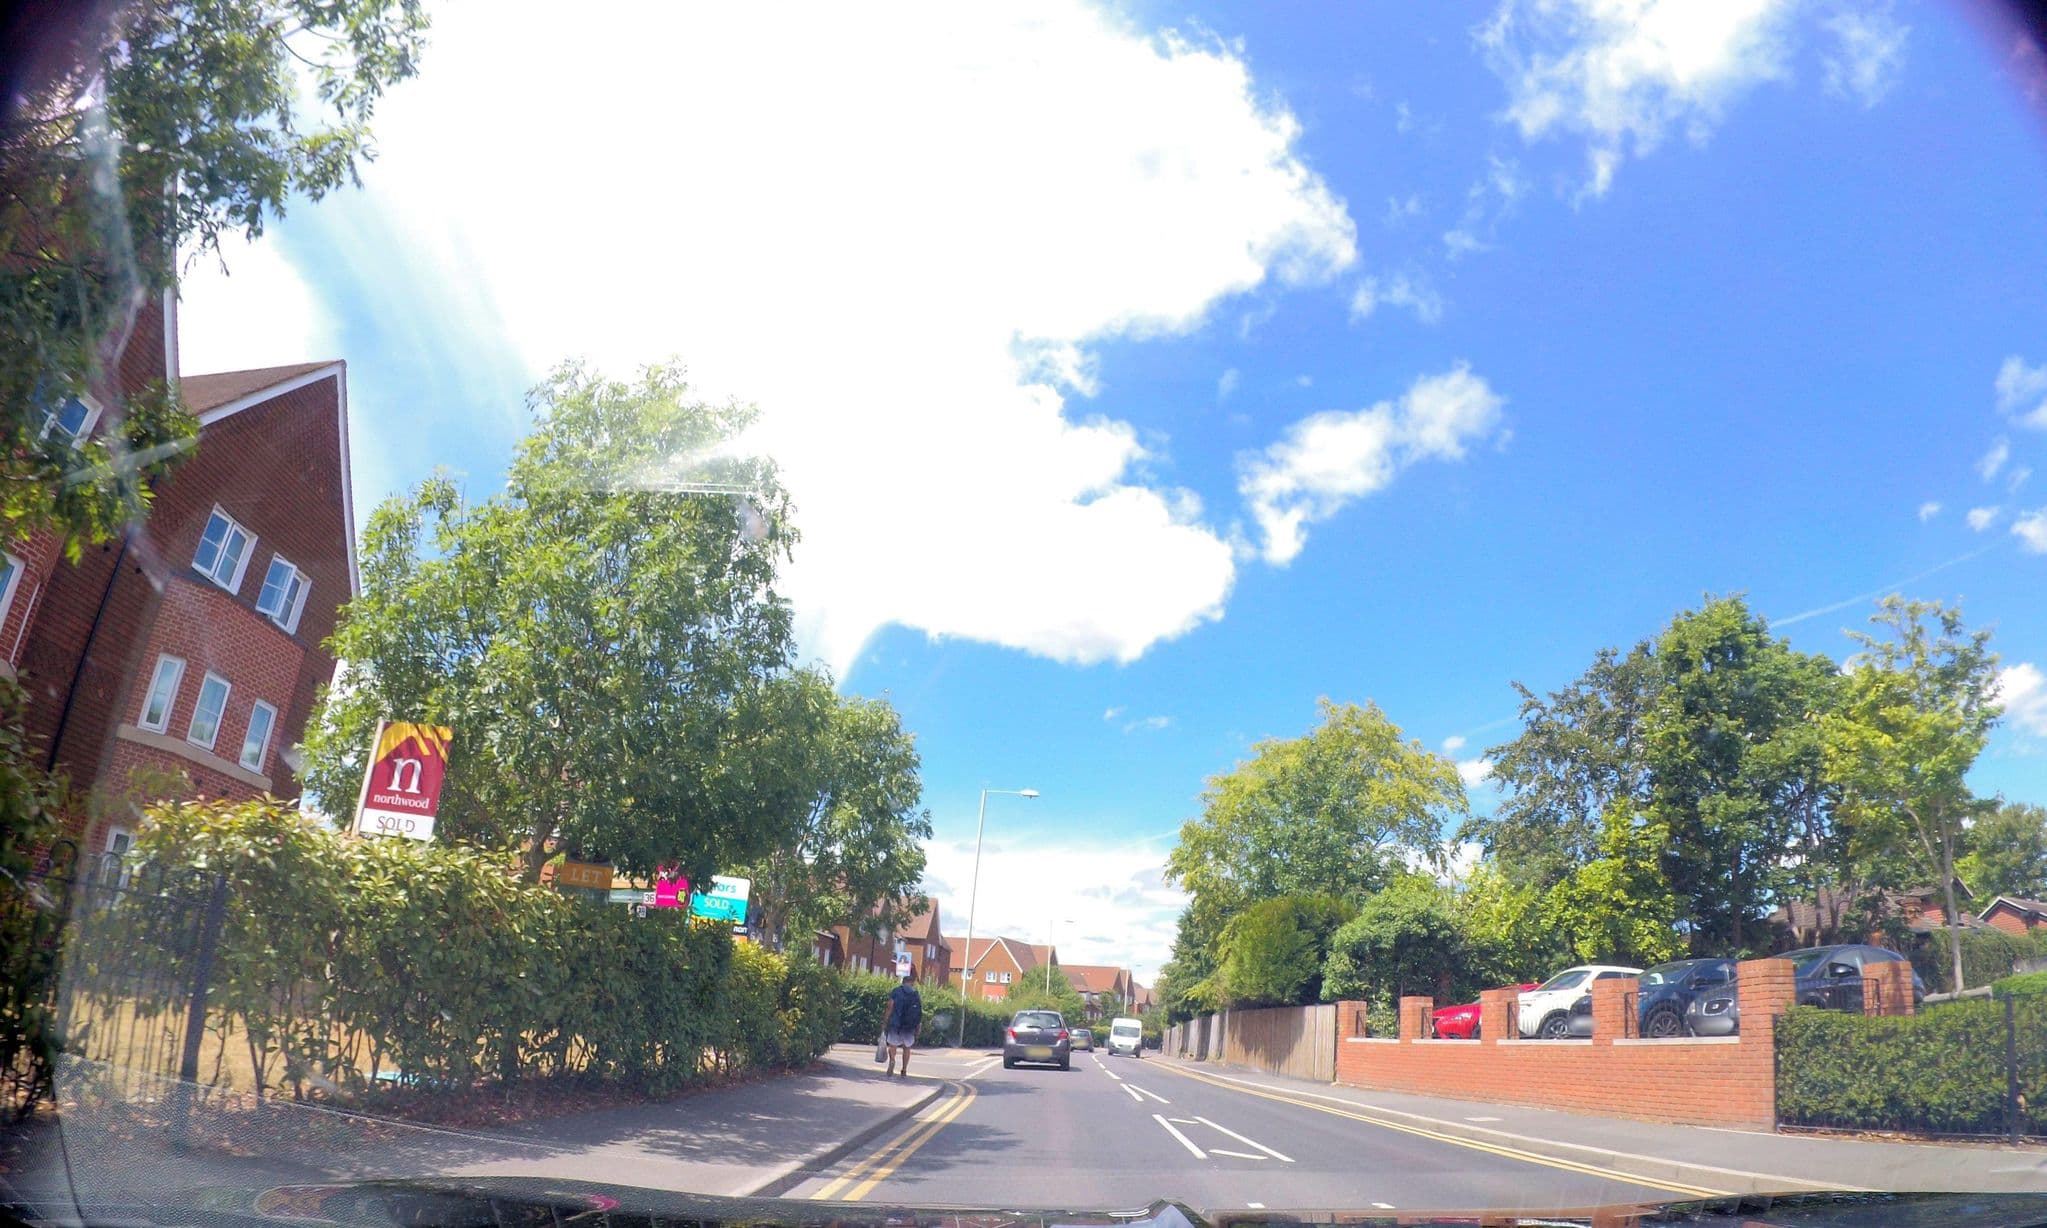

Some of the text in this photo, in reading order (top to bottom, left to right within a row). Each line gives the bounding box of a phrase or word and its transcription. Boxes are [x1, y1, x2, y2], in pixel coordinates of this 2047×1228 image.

[387, 757, 422, 794] n
[373, 794, 430, 809] northwood
[376, 816, 416, 832] SOLD
[570, 867, 604, 884] LET
[645, 893, 655, 903] 36
[703, 897, 730, 910] SOLD
